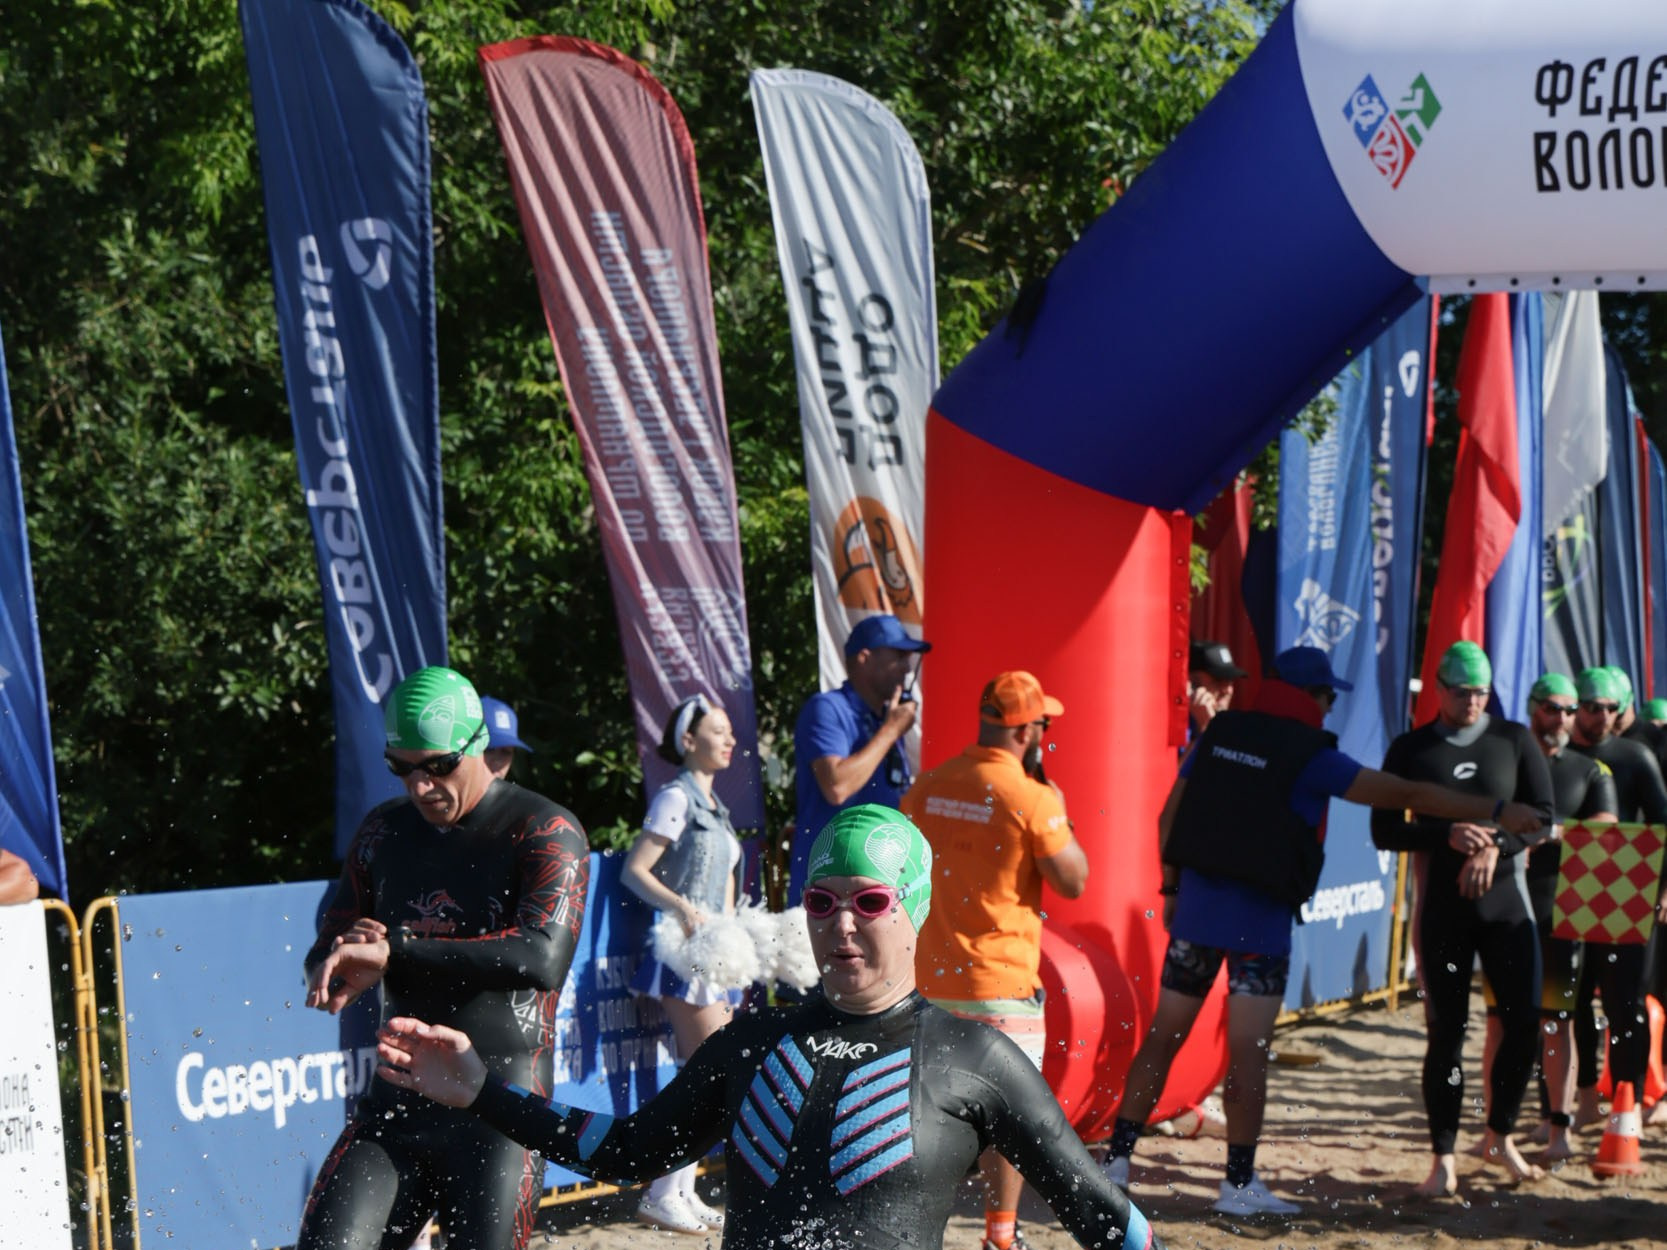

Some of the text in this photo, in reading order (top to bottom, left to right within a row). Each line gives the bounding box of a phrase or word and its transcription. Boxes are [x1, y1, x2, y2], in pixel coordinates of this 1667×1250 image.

[1535, 55, 1667, 123] ФЕДЕ
[1533, 126, 1667, 193] ВОЛО
[176, 1048, 379, 1130] Северстал
